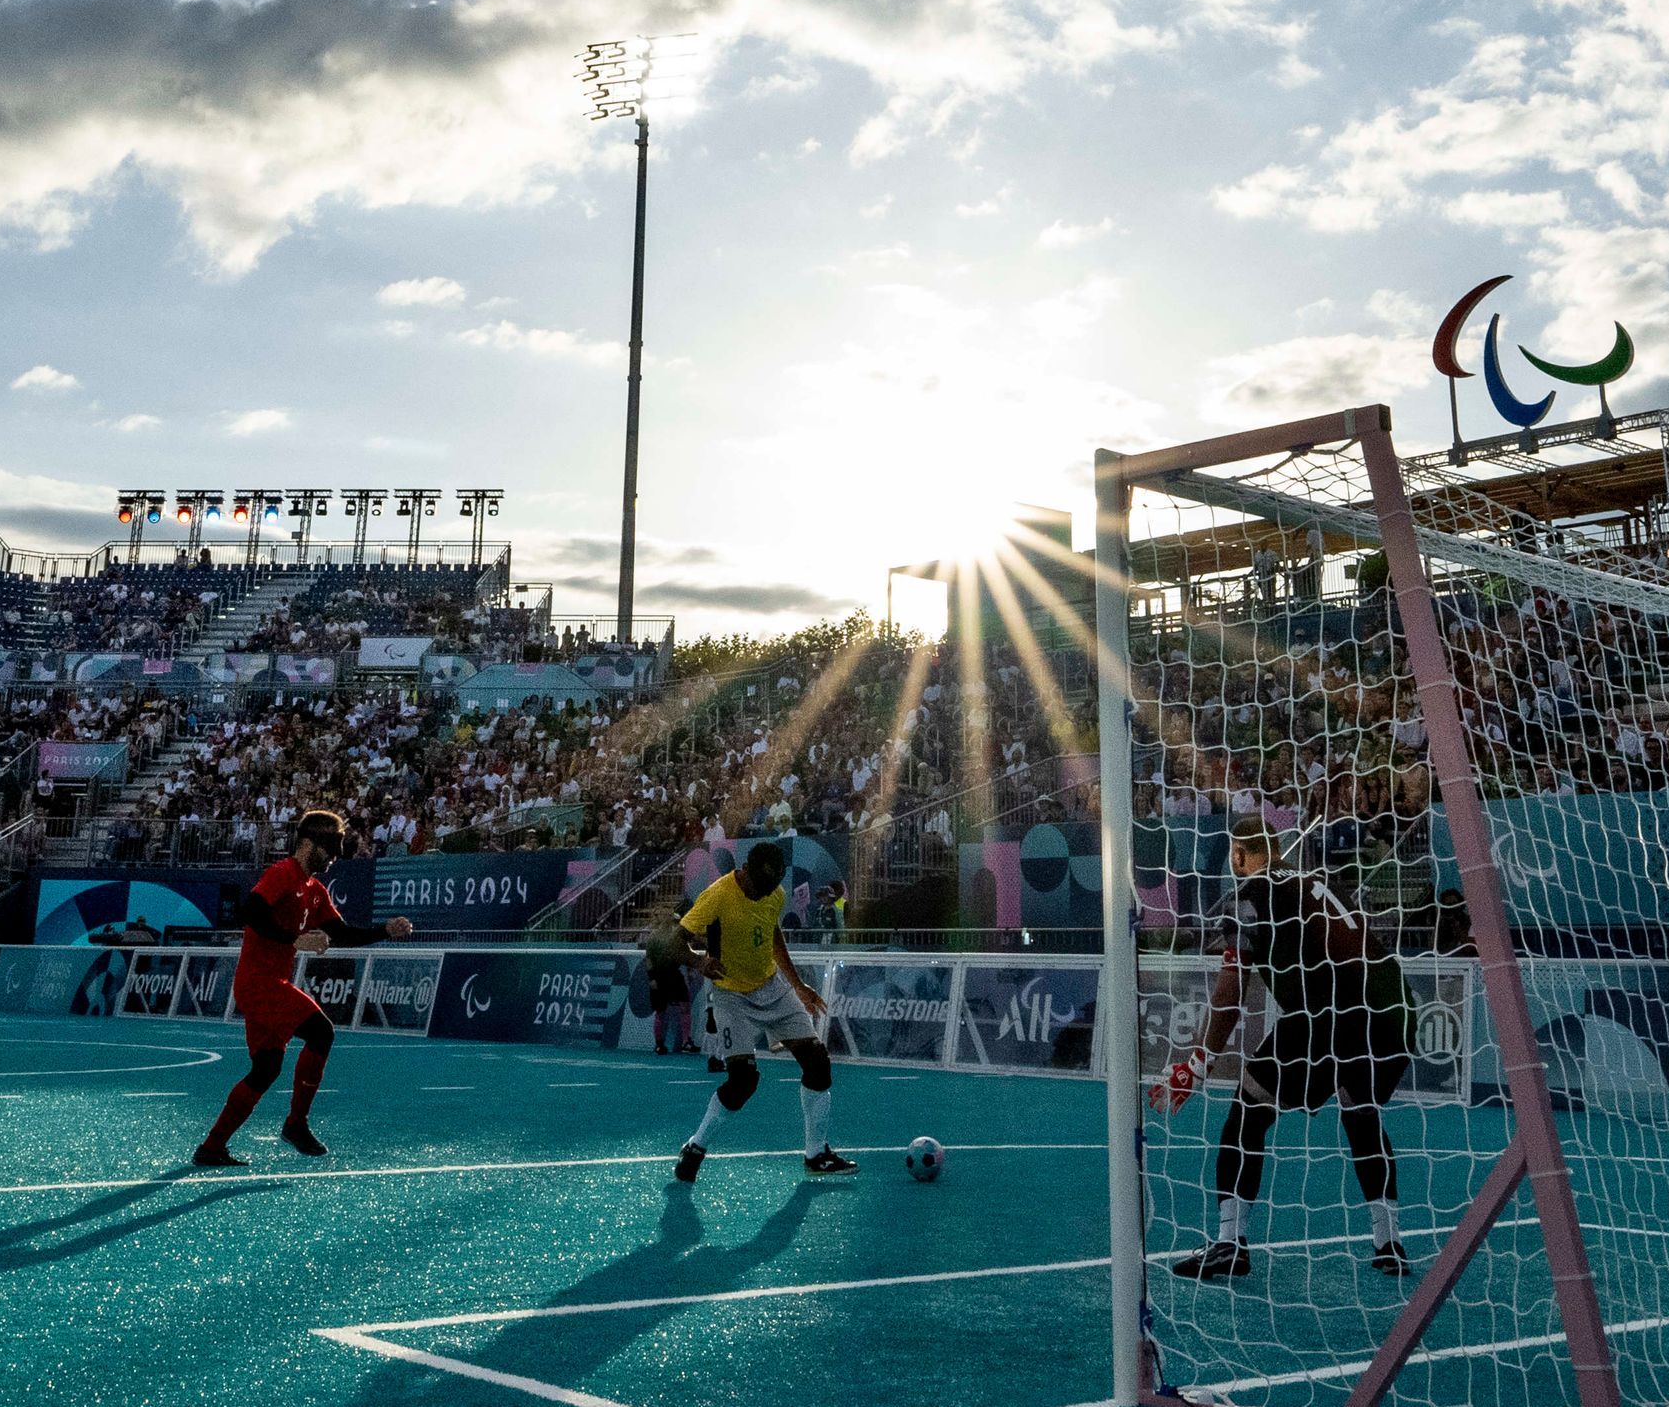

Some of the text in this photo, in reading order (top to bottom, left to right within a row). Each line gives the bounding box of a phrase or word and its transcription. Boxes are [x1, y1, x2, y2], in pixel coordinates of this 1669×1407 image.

[464, 875, 528, 905] 2024
[1310, 880, 1359, 930] 1
[533, 1000, 586, 1026] 2024
[722, 1026, 732, 1049] 8
